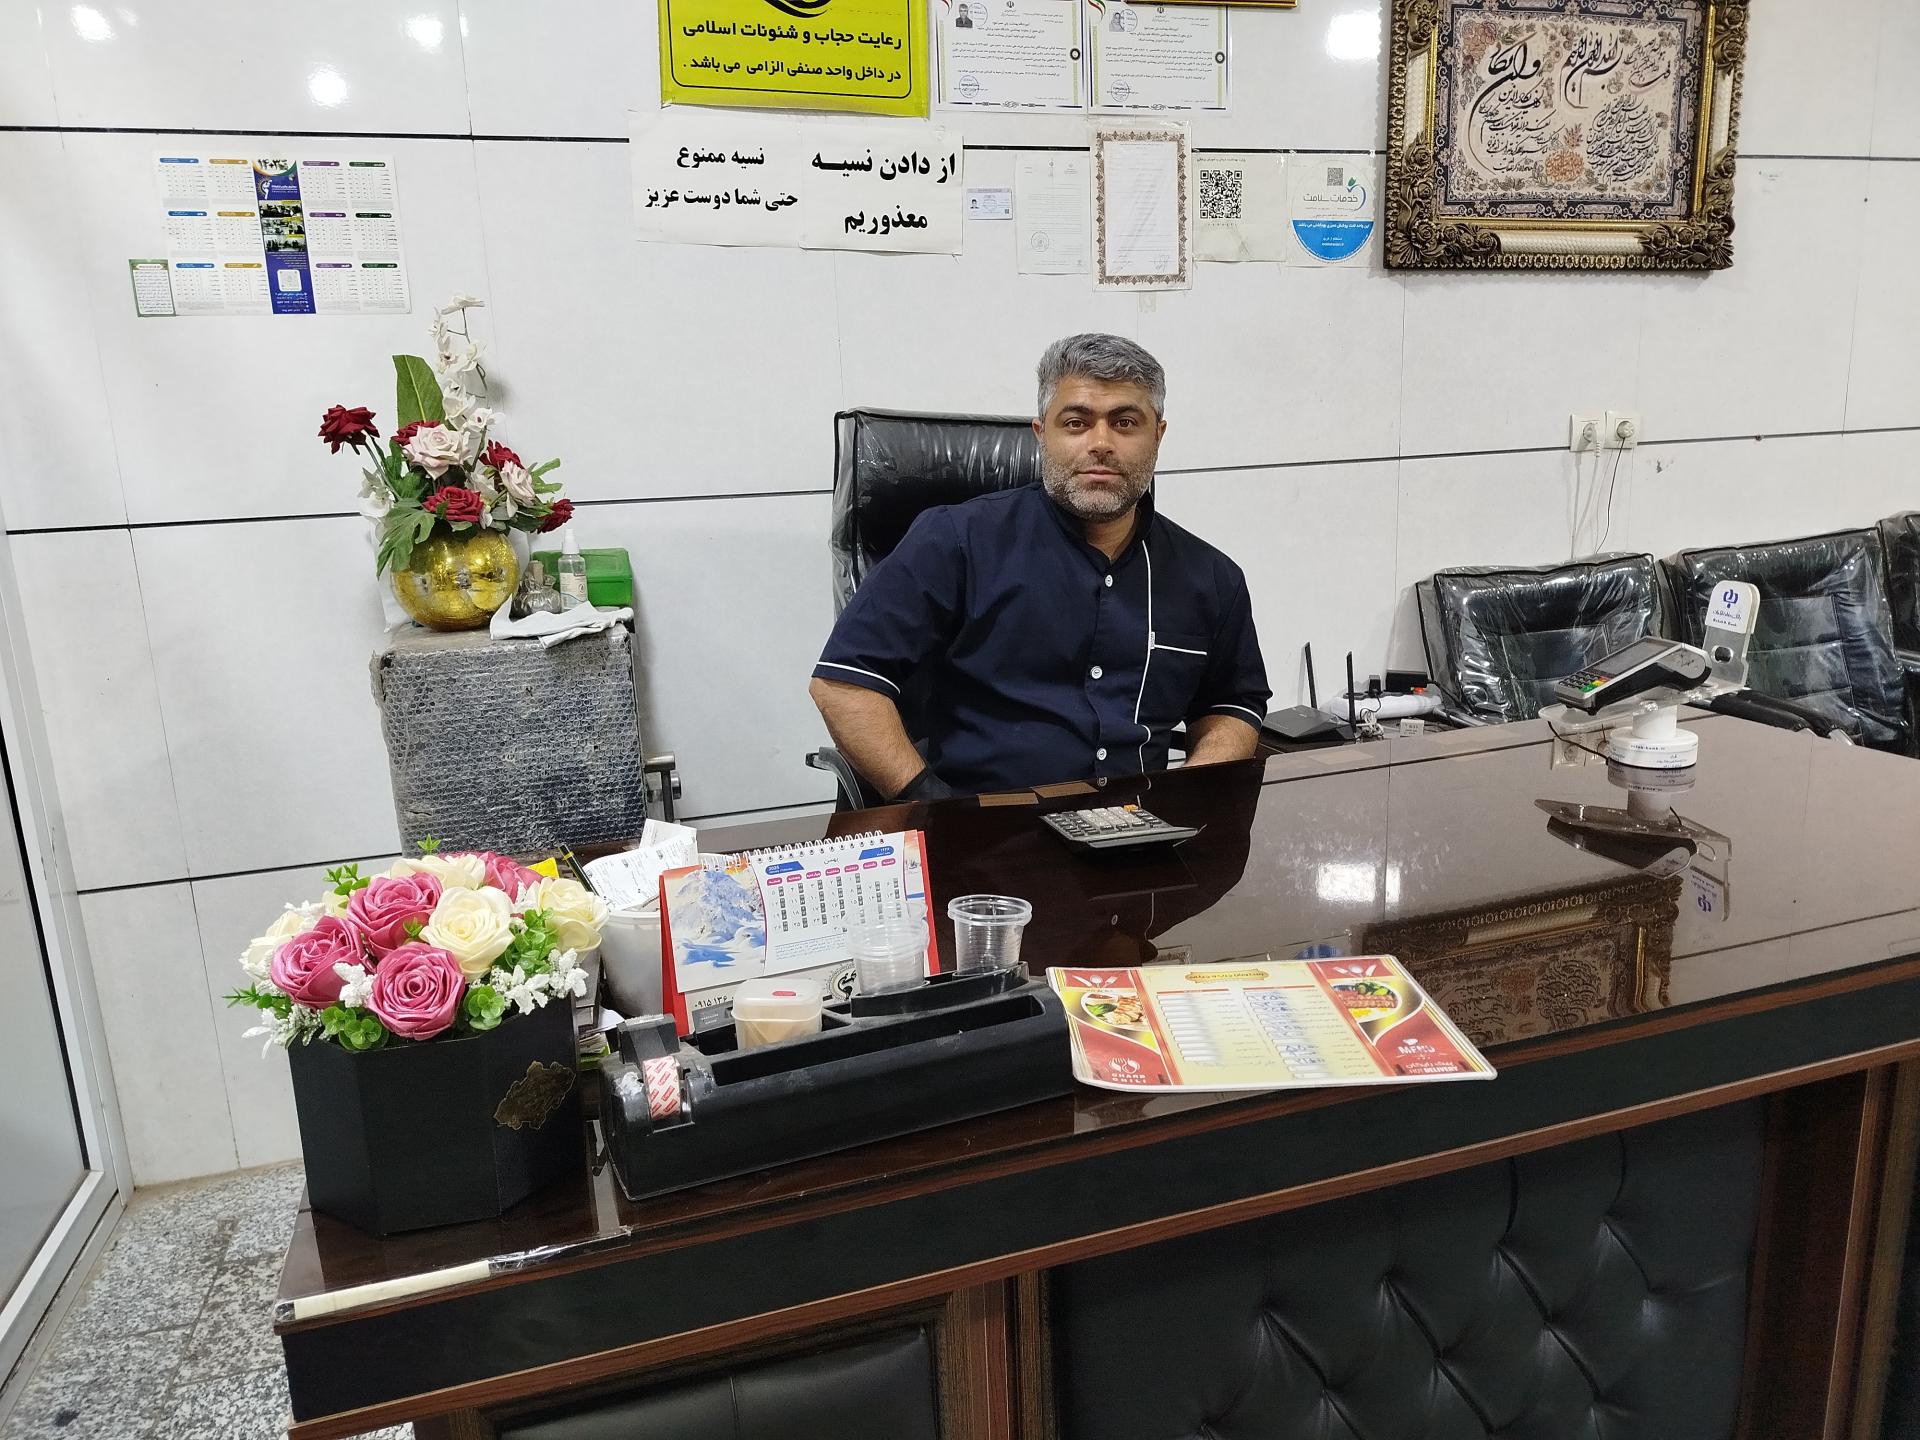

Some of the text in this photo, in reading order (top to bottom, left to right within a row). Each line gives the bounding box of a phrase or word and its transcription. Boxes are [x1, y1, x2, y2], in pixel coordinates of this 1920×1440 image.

[682, 20, 902, 49] رعایت حجاب و شئونات اسلامی
[723, 61, 741, 73] می
[746, 60, 784, 76] الزامی
[787, 62, 823, 77] صنفی
[826, 65, 853, 80] واحد
[855, 66, 885, 81] داخل
[887, 70, 901, 82] در
[676, 146, 765, 169] نسیه ممنوع
[880, 151, 930, 180] دادن
[936, 152, 955, 183] از
[644, 187, 798, 212] حتی شما دوست عزیز
[1330, 194, 1358, 202] خدمات
[844, 205, 928, 235] معذوریم
[1398, 1045, 1436, 1054] MENU
